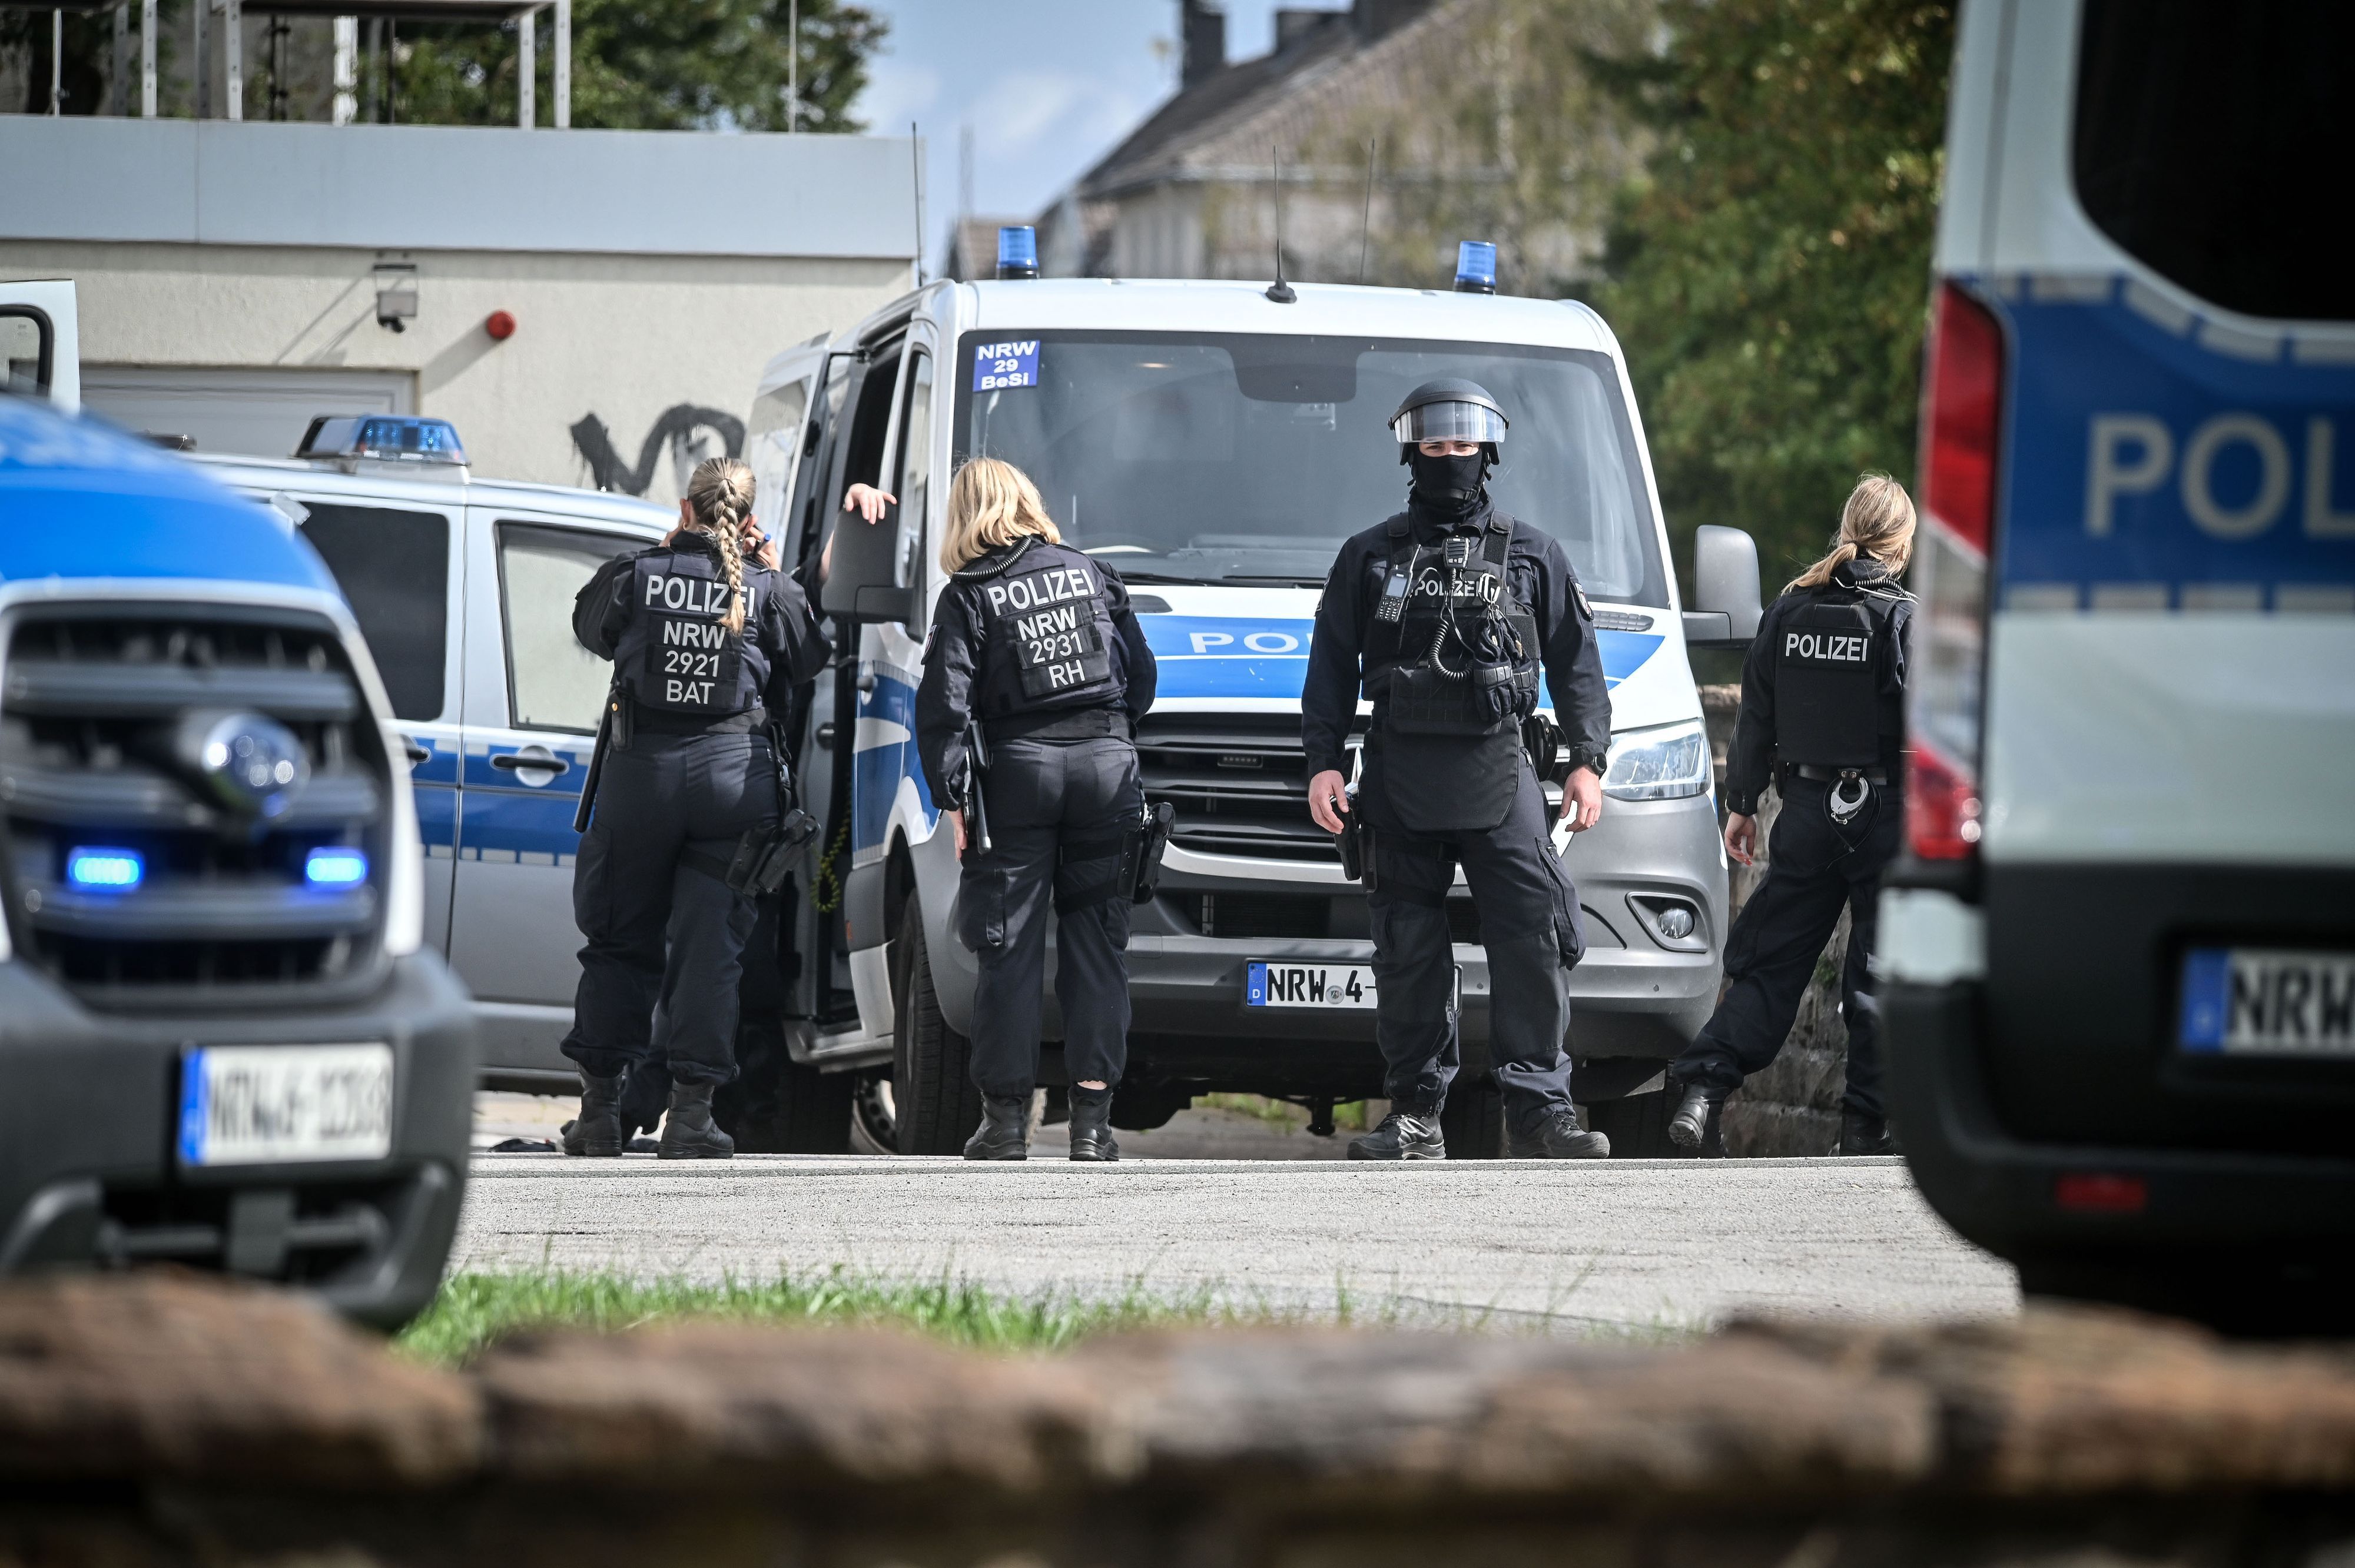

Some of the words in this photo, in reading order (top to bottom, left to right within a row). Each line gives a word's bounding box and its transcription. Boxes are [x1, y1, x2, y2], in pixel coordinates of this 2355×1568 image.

[978, 341, 1036, 360] NRW
[993, 358, 1019, 373] 29
[2082, 411, 2355, 538] POL
[987, 569, 1094, 616] POLIZEI
[663, 621, 726, 649] NRW
[1017, 606, 1076, 641] NRW
[1029, 632, 1083, 664] 2931
[1786, 633, 1868, 661] POLIZEI
[665, 650, 719, 677] 2921
[1049, 659, 1086, 688] RH
[666, 679, 715, 705] BAT
[1252, 989, 1261, 999] D
[1267, 968, 1326, 1002] NRW
